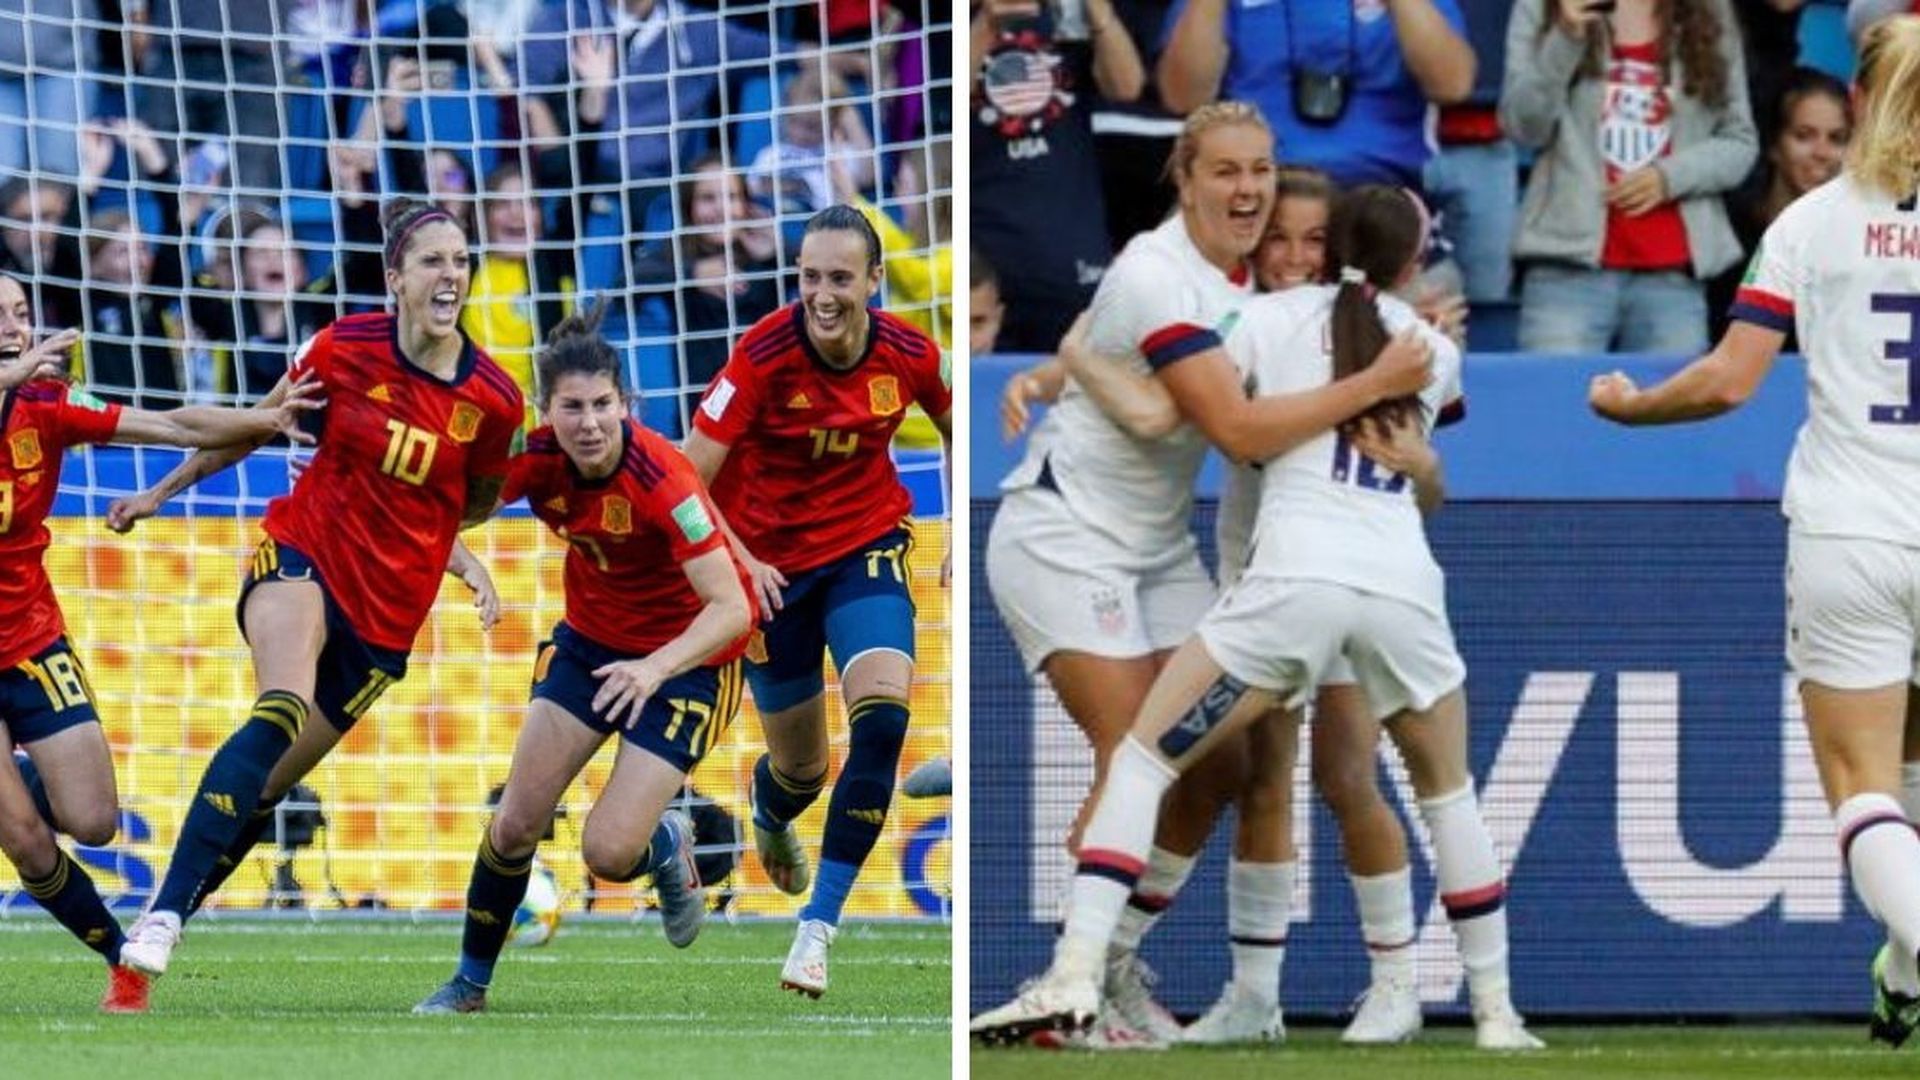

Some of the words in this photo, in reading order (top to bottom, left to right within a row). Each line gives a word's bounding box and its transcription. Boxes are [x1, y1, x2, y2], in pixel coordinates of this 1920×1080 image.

[1008, 137, 1049, 159] USA
[1869, 293, 1920, 424] 3
[381, 418, 438, 486] 10
[809, 428, 859, 460] 14
[38, 652, 88, 712] 18
[664, 699, 710, 756] 17
